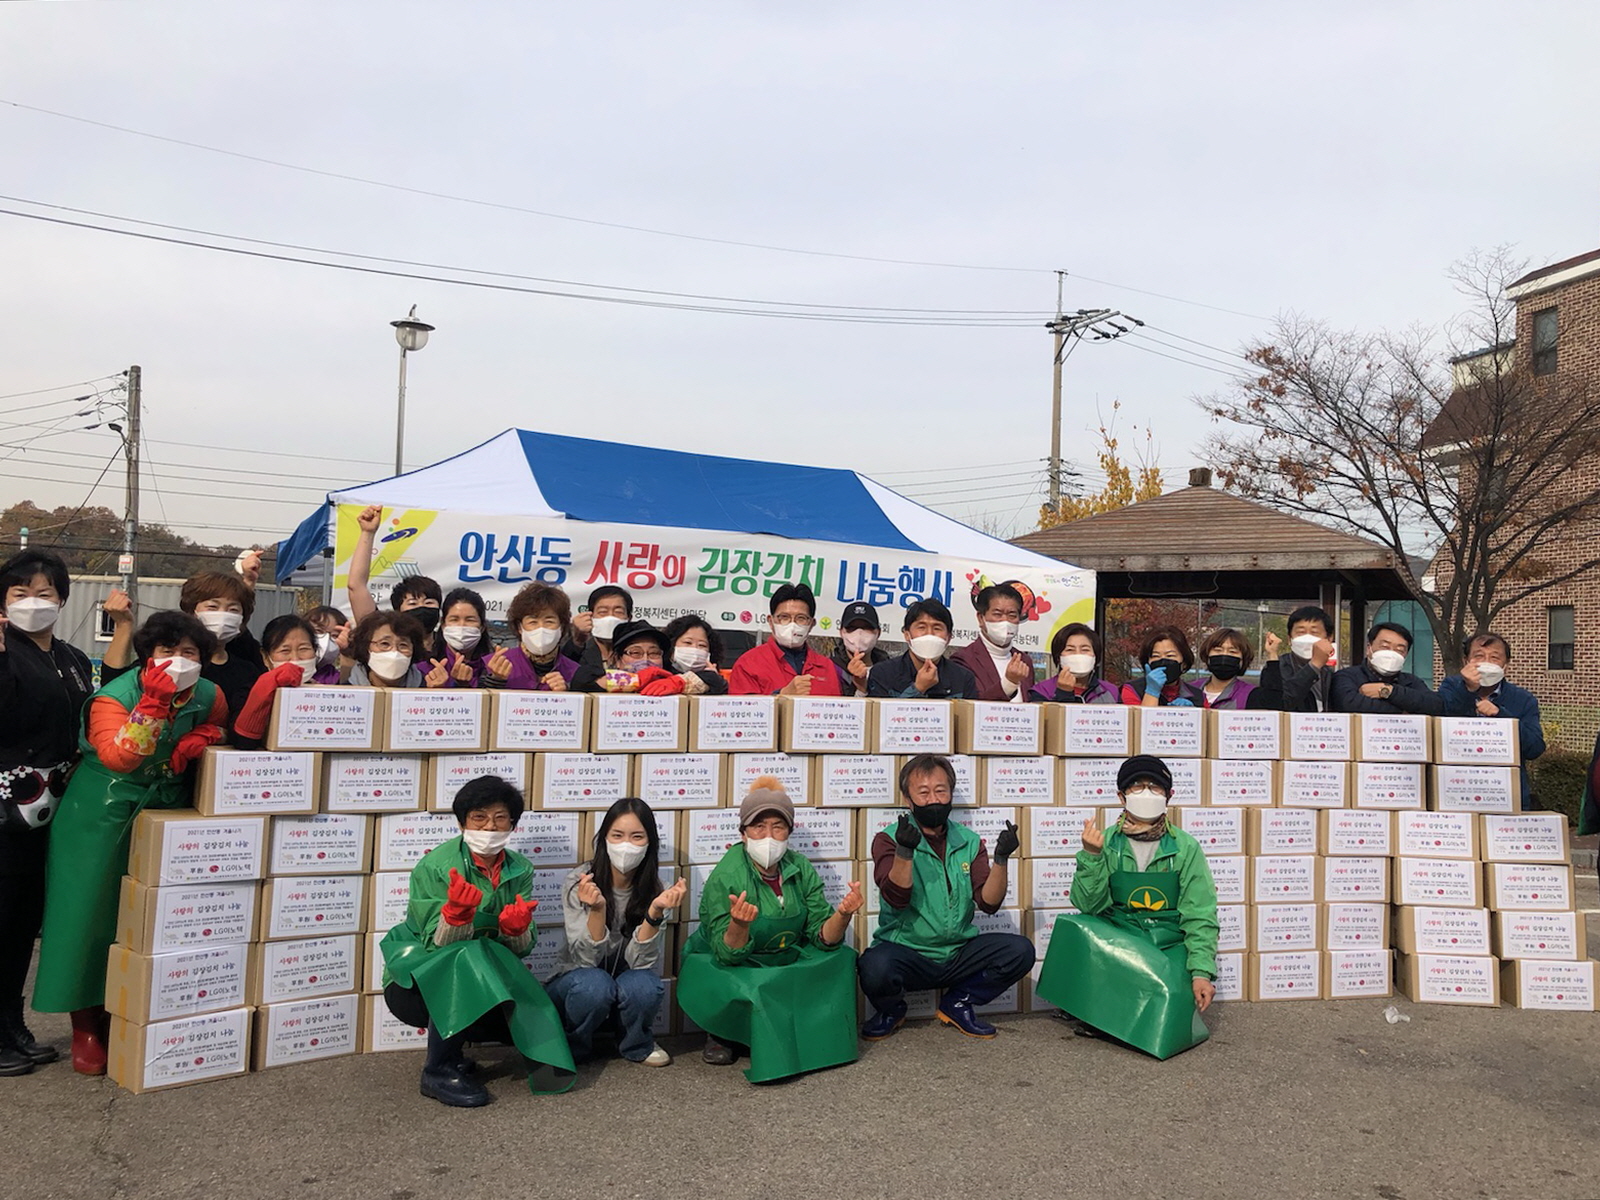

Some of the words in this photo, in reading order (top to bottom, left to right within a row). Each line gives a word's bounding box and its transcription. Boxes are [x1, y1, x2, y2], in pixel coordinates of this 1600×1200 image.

[457, 531, 572, 586] 안산동
[584, 540, 686, 590] 사랑의
[696, 547, 825, 599] 김장김치
[836, 559, 955, 609] 나눔행사
[484, 601, 507, 612] 021.
[634, 607, 678, 620] 정복지센터
[755, 613, 768, 624] LG
